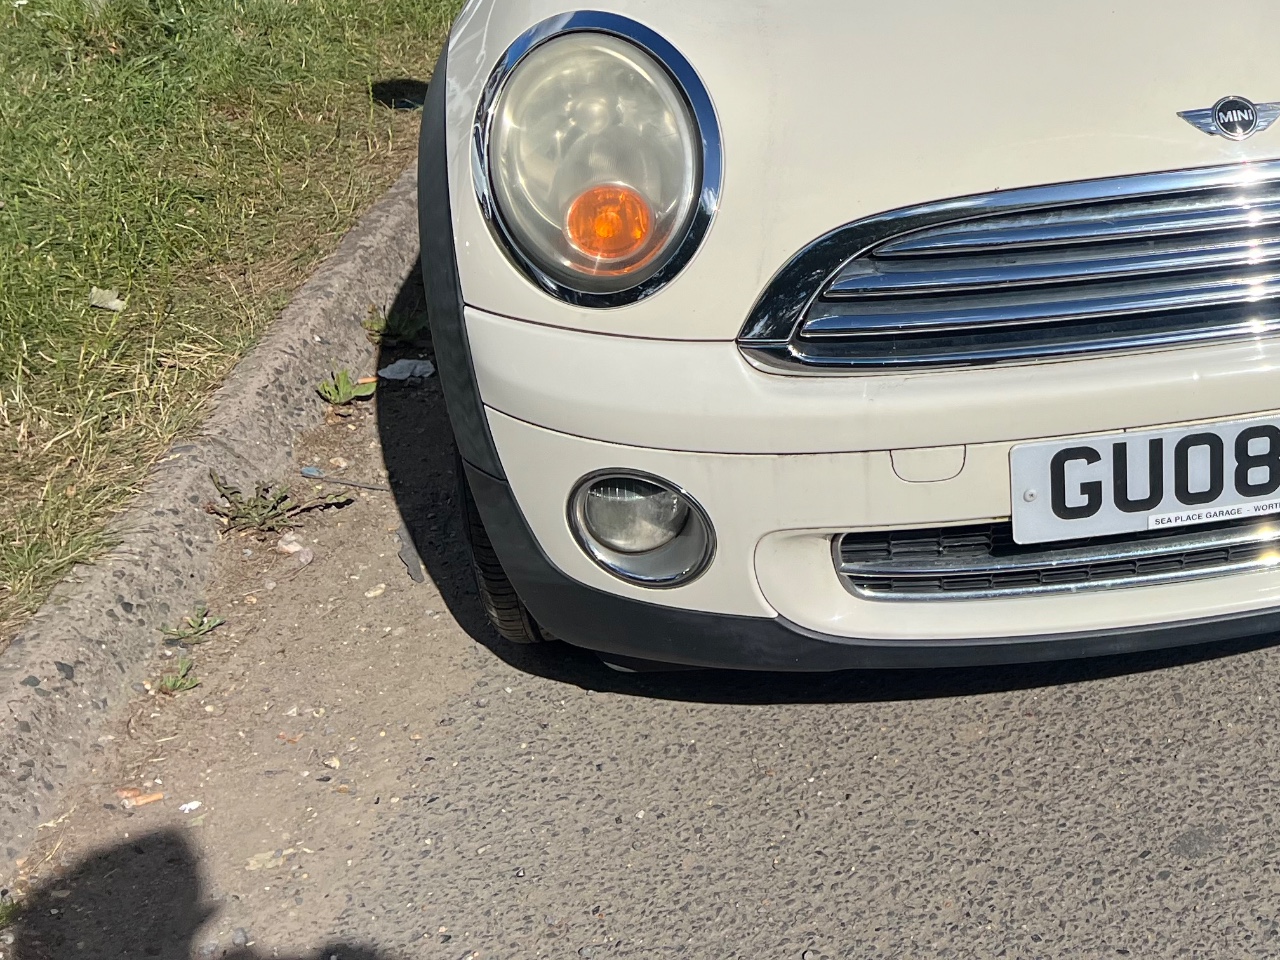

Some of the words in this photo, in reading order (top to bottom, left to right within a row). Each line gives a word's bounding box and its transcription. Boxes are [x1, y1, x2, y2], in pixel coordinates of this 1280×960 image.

[1219, 109, 1253, 123] MINI
[1155, 516, 1172, 525] SEA
[1175, 513, 1202, 523] PLACE
[1206, 508, 1242, 519] GARAGE
